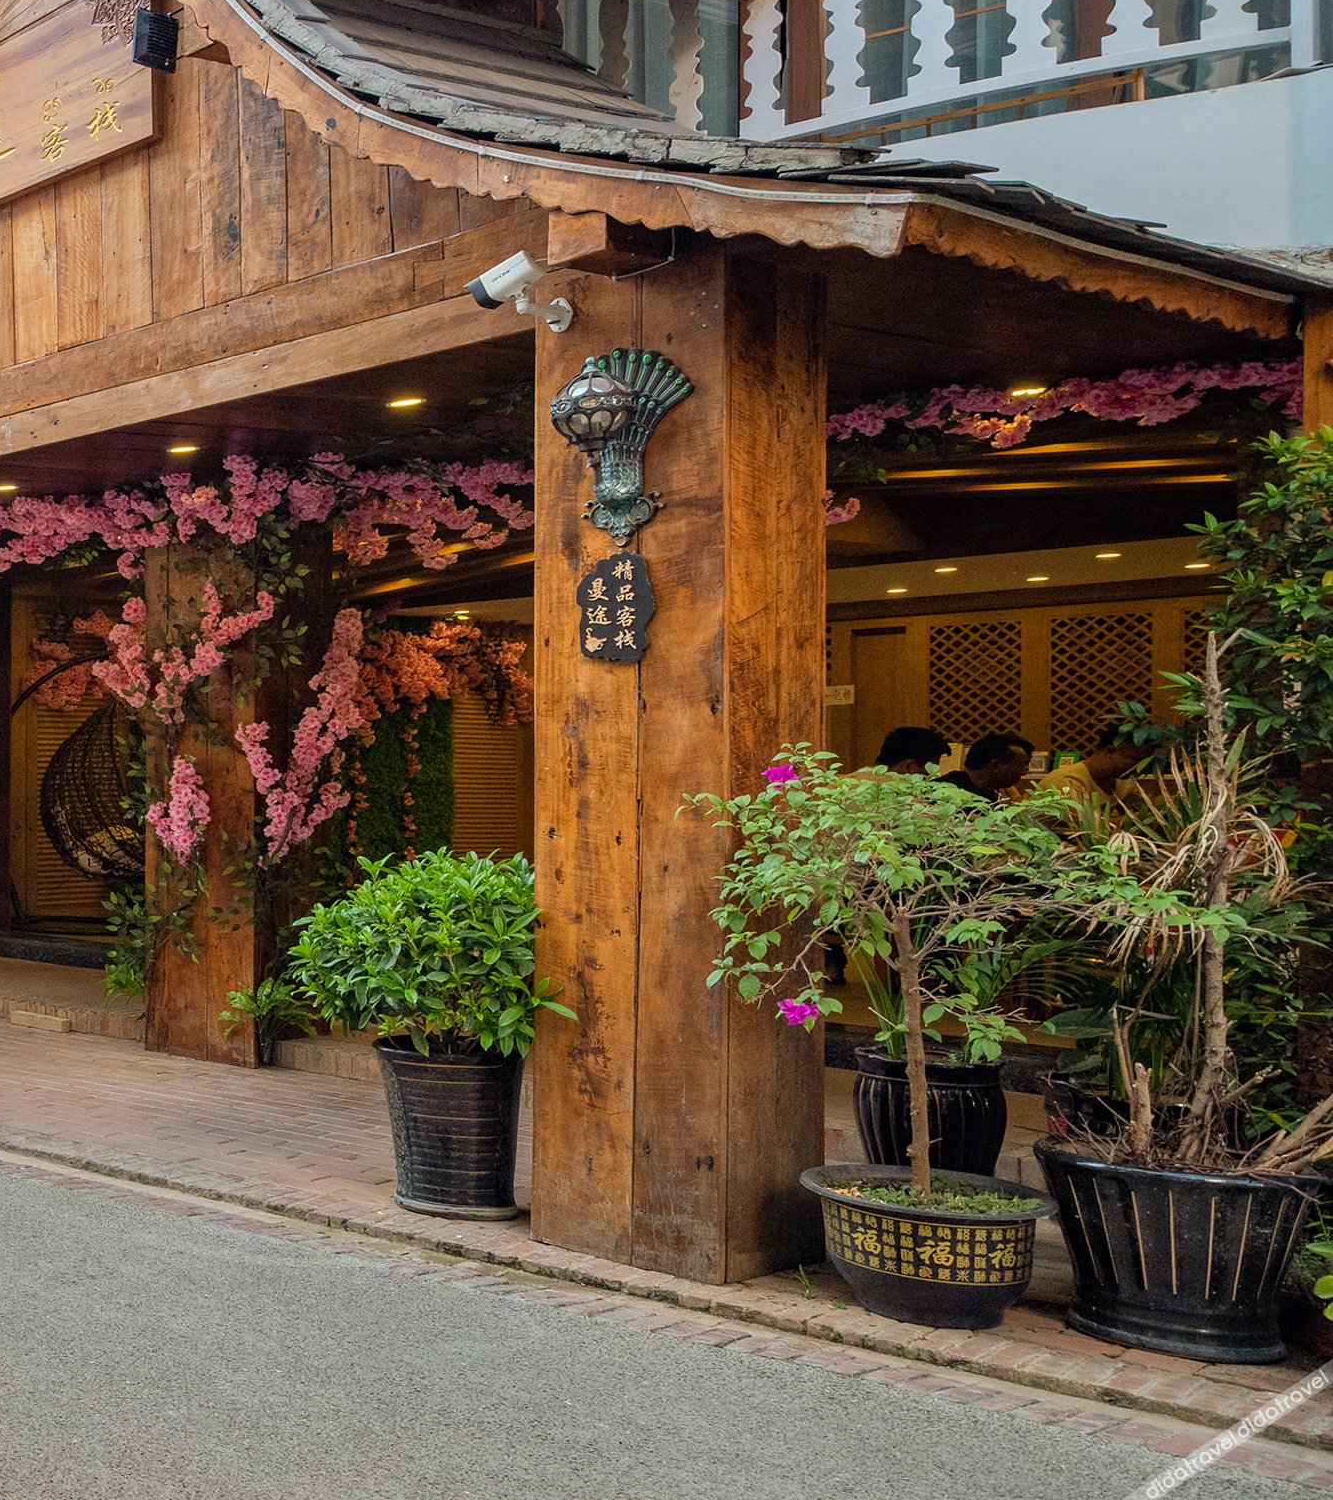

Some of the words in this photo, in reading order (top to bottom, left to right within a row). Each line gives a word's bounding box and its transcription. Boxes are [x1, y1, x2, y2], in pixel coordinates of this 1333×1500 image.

[612, 559, 637, 650] 精品客栈
[851, 1226, 882, 1255] 福
[916, 1238, 956, 1267] 福
[989, 1241, 1018, 1269] 福
